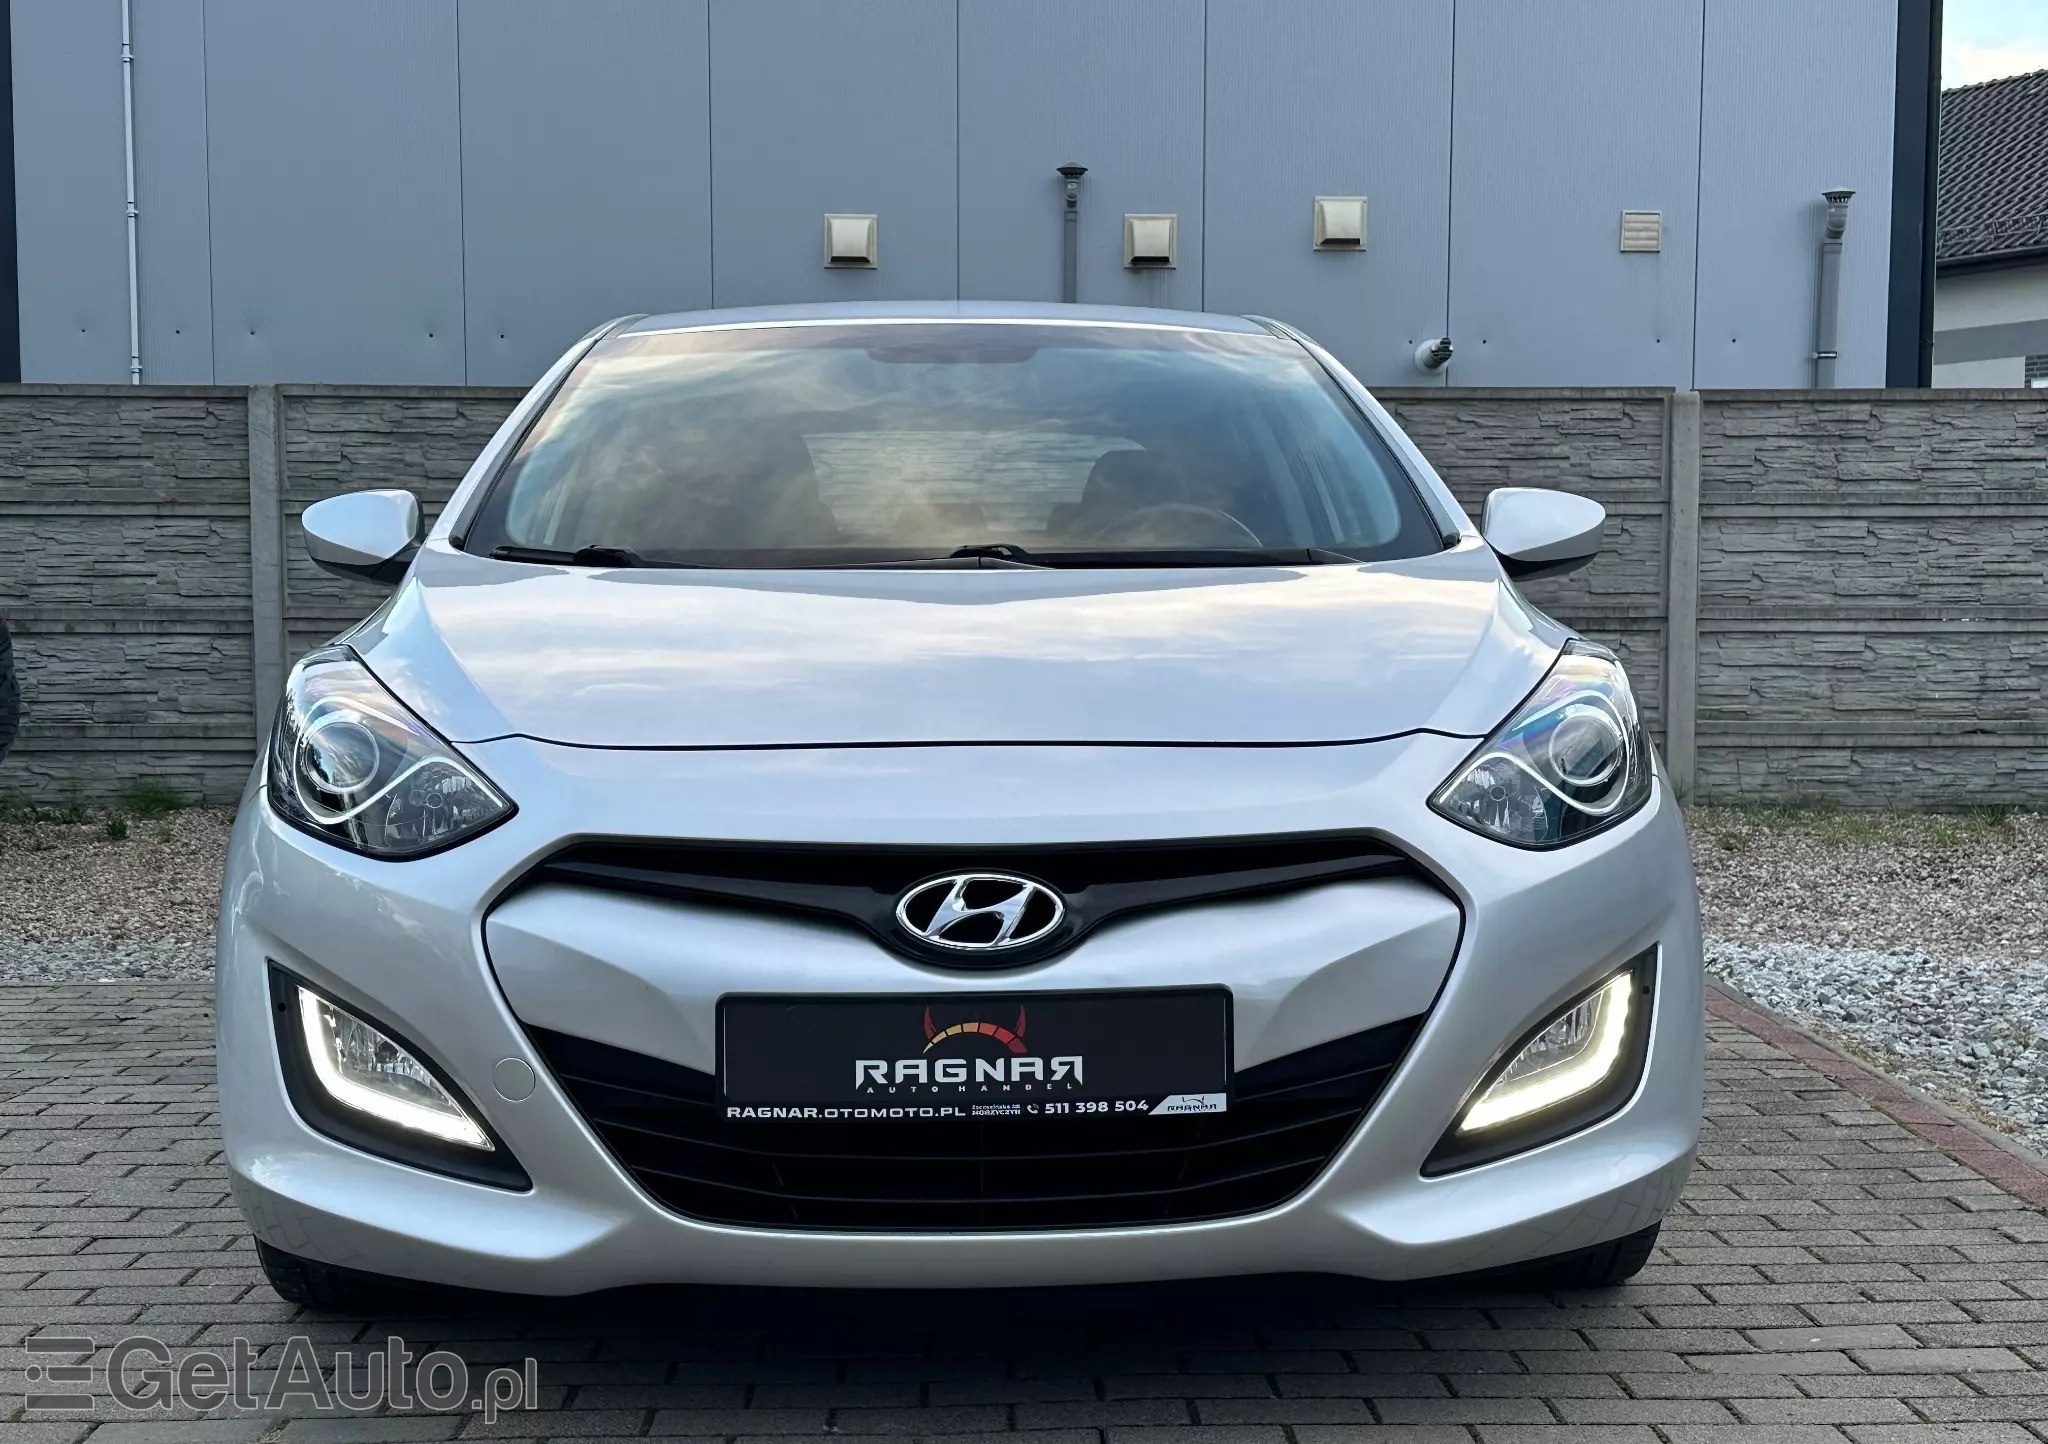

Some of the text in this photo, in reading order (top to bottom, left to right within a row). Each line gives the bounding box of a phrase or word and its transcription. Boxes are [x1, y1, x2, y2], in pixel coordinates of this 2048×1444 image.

[856, 1056, 1083, 1090] RAGNAR
[727, 1106, 966, 1119] RAGNAR.OTOMOTO.PL
[1045, 1100, 1149, 1114] 511 398 504
